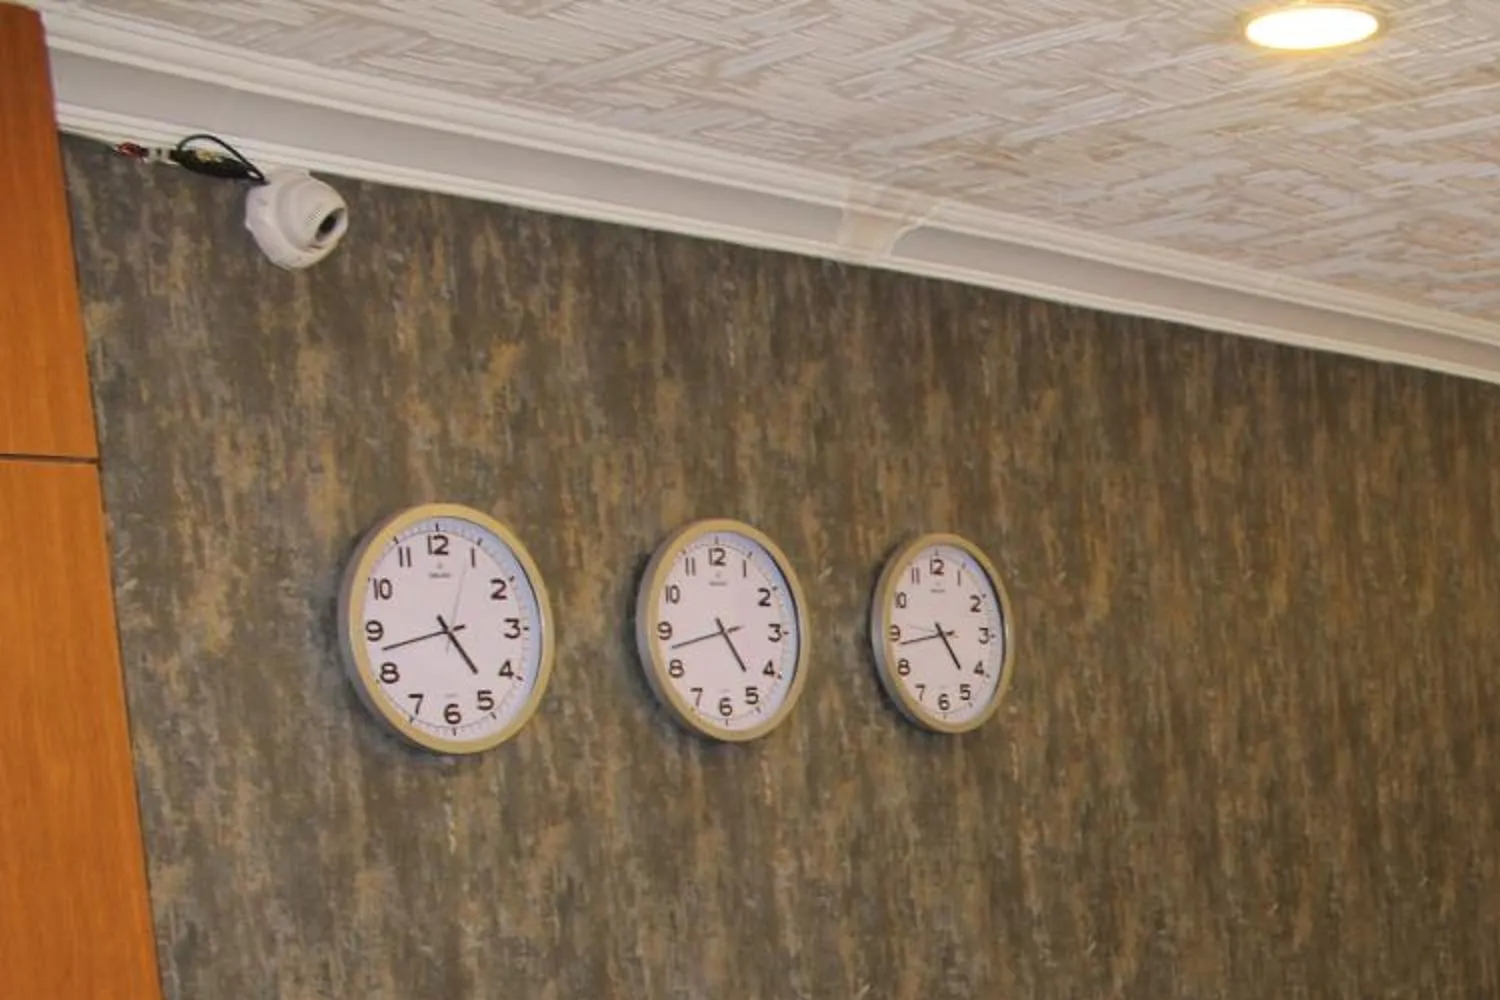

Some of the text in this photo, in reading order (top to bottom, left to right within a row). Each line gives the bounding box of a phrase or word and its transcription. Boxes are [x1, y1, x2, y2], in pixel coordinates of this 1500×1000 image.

[427, 535, 449, 555] 12
[398, 547, 412, 567] 11
[708, 548, 726, 566] 12
[684, 557, 696, 577] 11
[911, 567, 920, 585] 11
[929, 559, 945, 575] 12
[372, 578, 393, 600] 10
[490, 579, 507, 600] 2
[665, 585, 681, 604] 10
[757, 587, 772, 607] 2
[969, 594, 981, 613] 2
[365, 620, 384, 641] 9
[503, 618, 521, 639] 3
[657, 621, 673, 641] 9
[767, 623, 782, 642] 3
[978, 627, 990, 645] 3
[379, 662, 400, 684] 8
[498, 660, 515, 679] 4
[668, 659, 685, 678] 8
[763, 659, 775, 678] 4
[897, 658, 911, 676] 8
[973, 660, 985, 677] 4
[477, 690, 495, 711] 5
[690, 687, 703, 707] 7
[745, 687, 759, 705] 5
[915, 684, 926, 701] 7
[959, 683, 971, 701] 5
[408, 693, 424, 715] 7
[718, 697, 733, 717] 6
[938, 693, 950, 711] 6
[444, 703, 462, 724] 6
